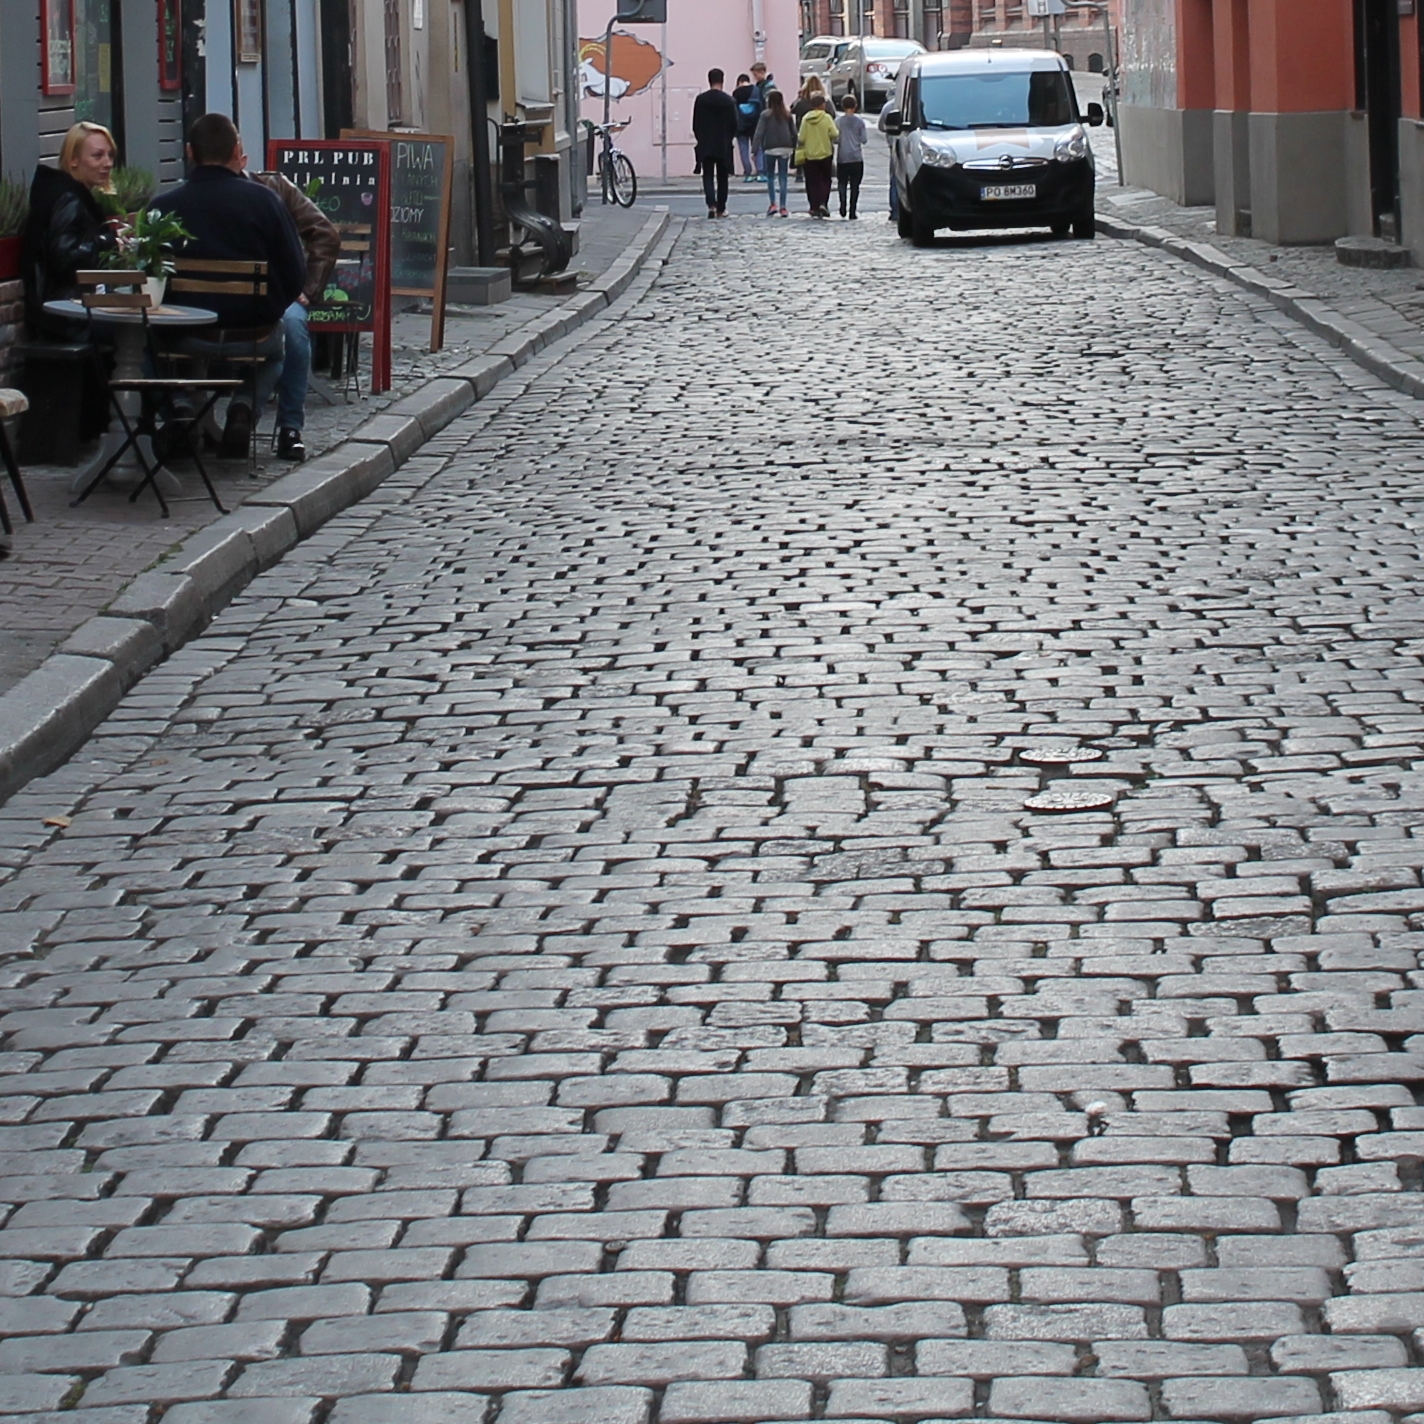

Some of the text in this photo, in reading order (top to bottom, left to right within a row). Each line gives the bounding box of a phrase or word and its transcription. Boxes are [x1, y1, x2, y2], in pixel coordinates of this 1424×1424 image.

[283, 151, 374, 166] PRL PUB
[396, 142, 434, 170] PIWA
